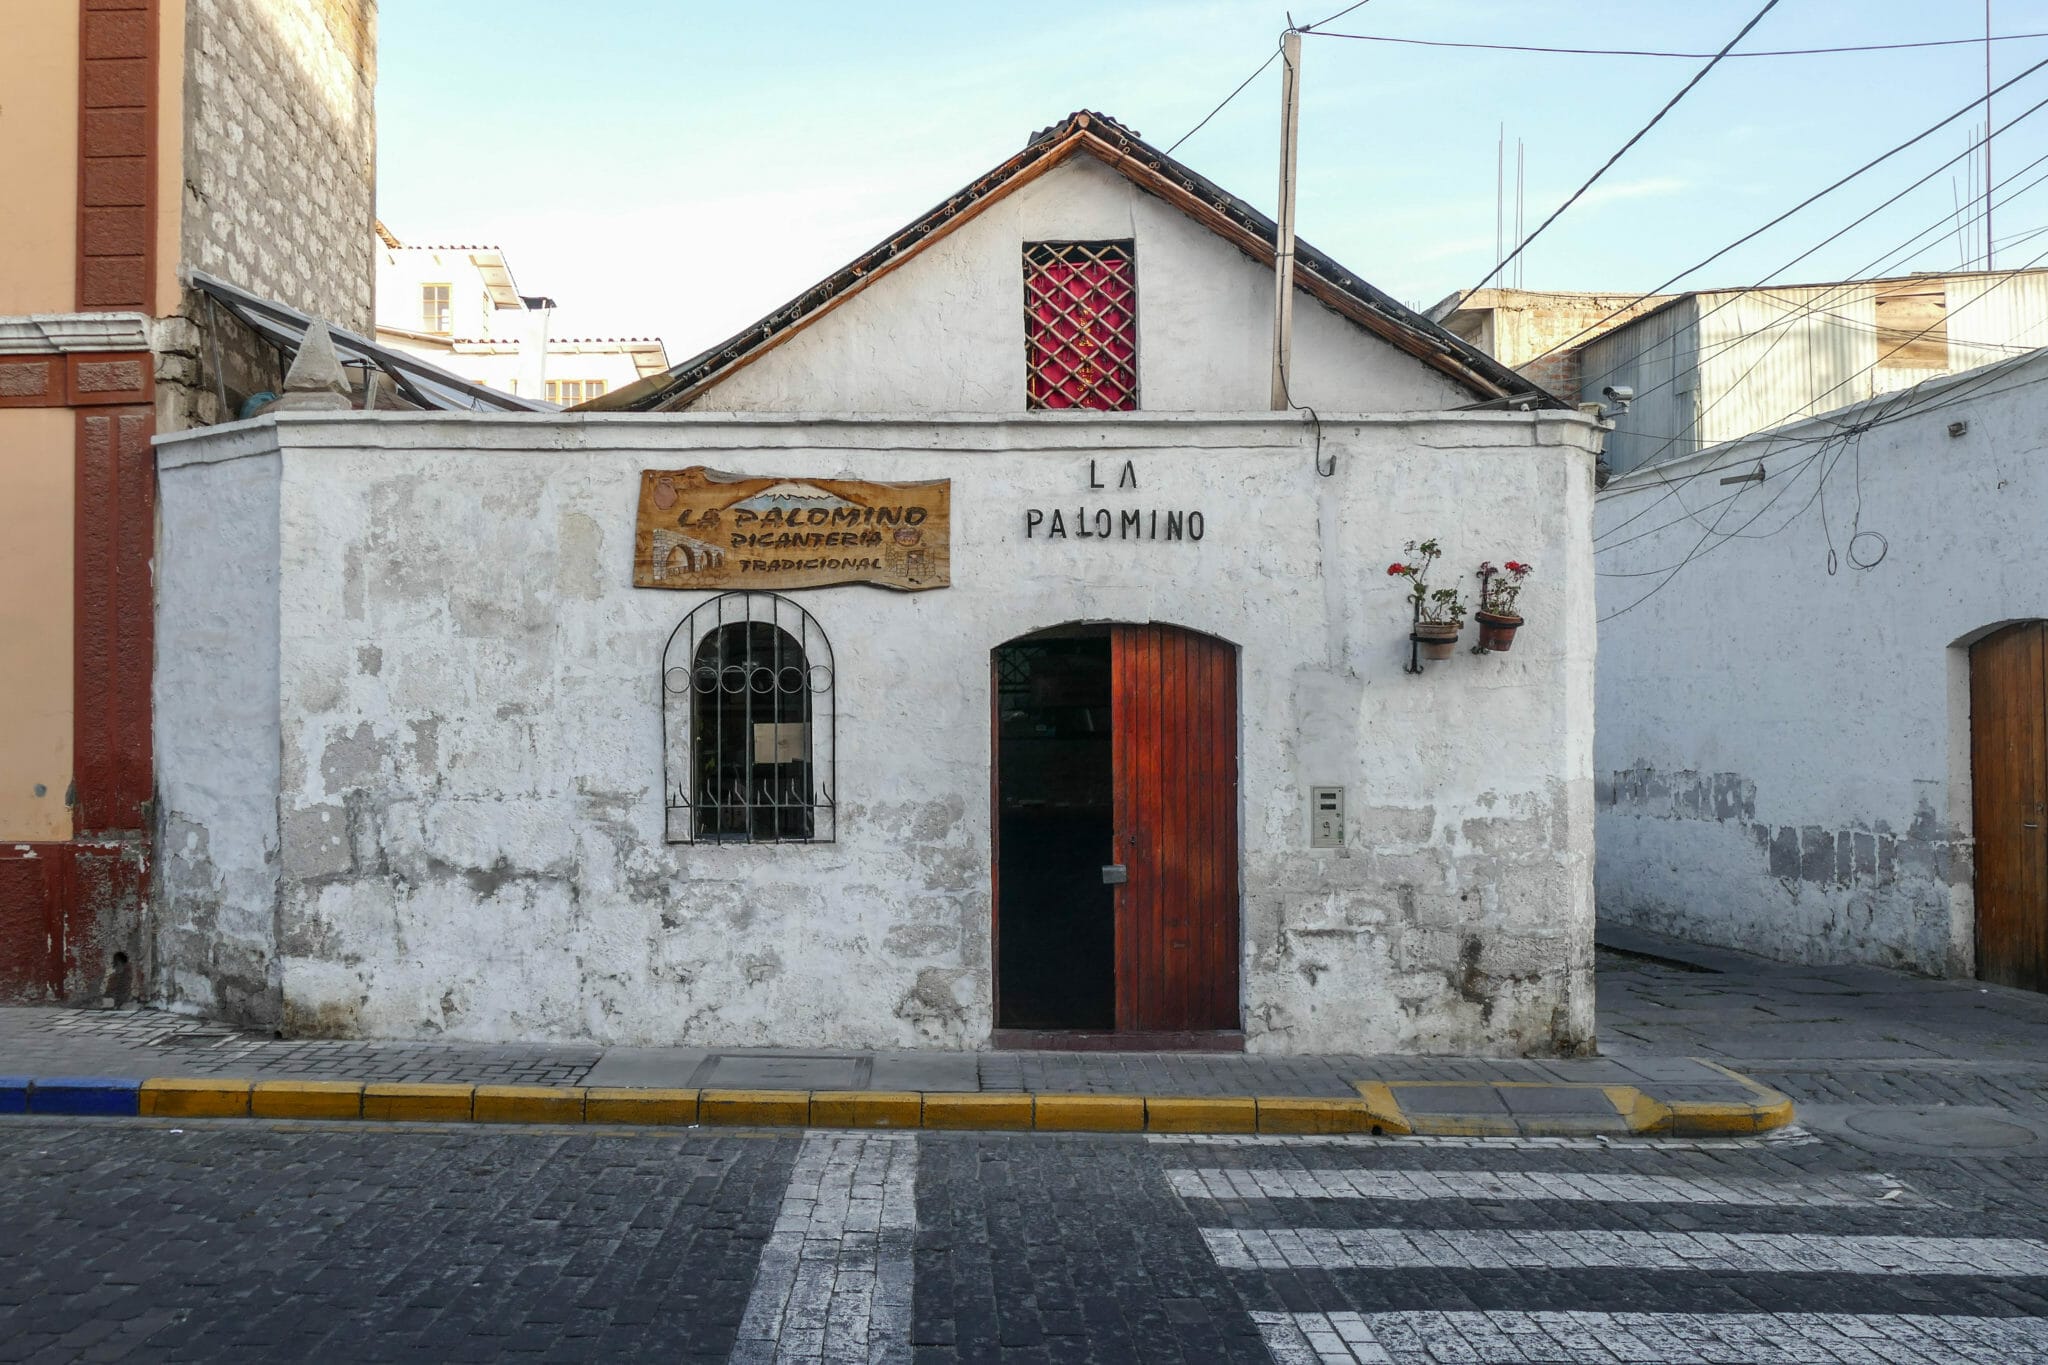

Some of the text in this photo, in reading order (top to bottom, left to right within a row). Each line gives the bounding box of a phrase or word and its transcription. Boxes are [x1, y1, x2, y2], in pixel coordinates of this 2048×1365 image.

[1090, 459, 1138, 489] LA
[677, 505, 928, 529] LA PALOMINO
[1026, 506, 1205, 541] PALOMINO
[739, 557, 882, 573] TRADICIONAL
